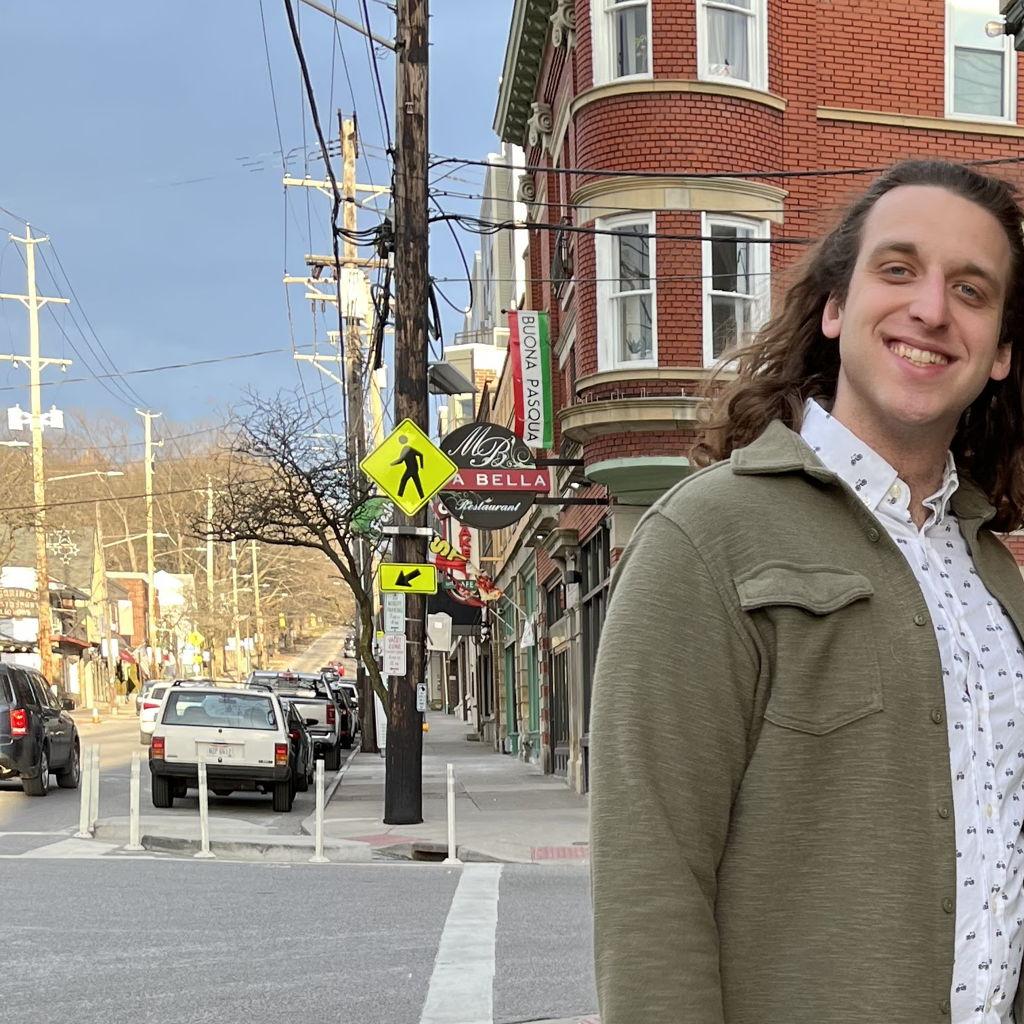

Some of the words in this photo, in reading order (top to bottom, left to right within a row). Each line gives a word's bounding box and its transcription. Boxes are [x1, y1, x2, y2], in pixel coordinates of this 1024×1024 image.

[521, 316, 538, 370] BUONA
[526, 379, 541, 441] PASQUA
[452, 476, 464, 486] A
[476, 473, 546, 487] BELLA
[455, 500, 521, 512] Restaurant
